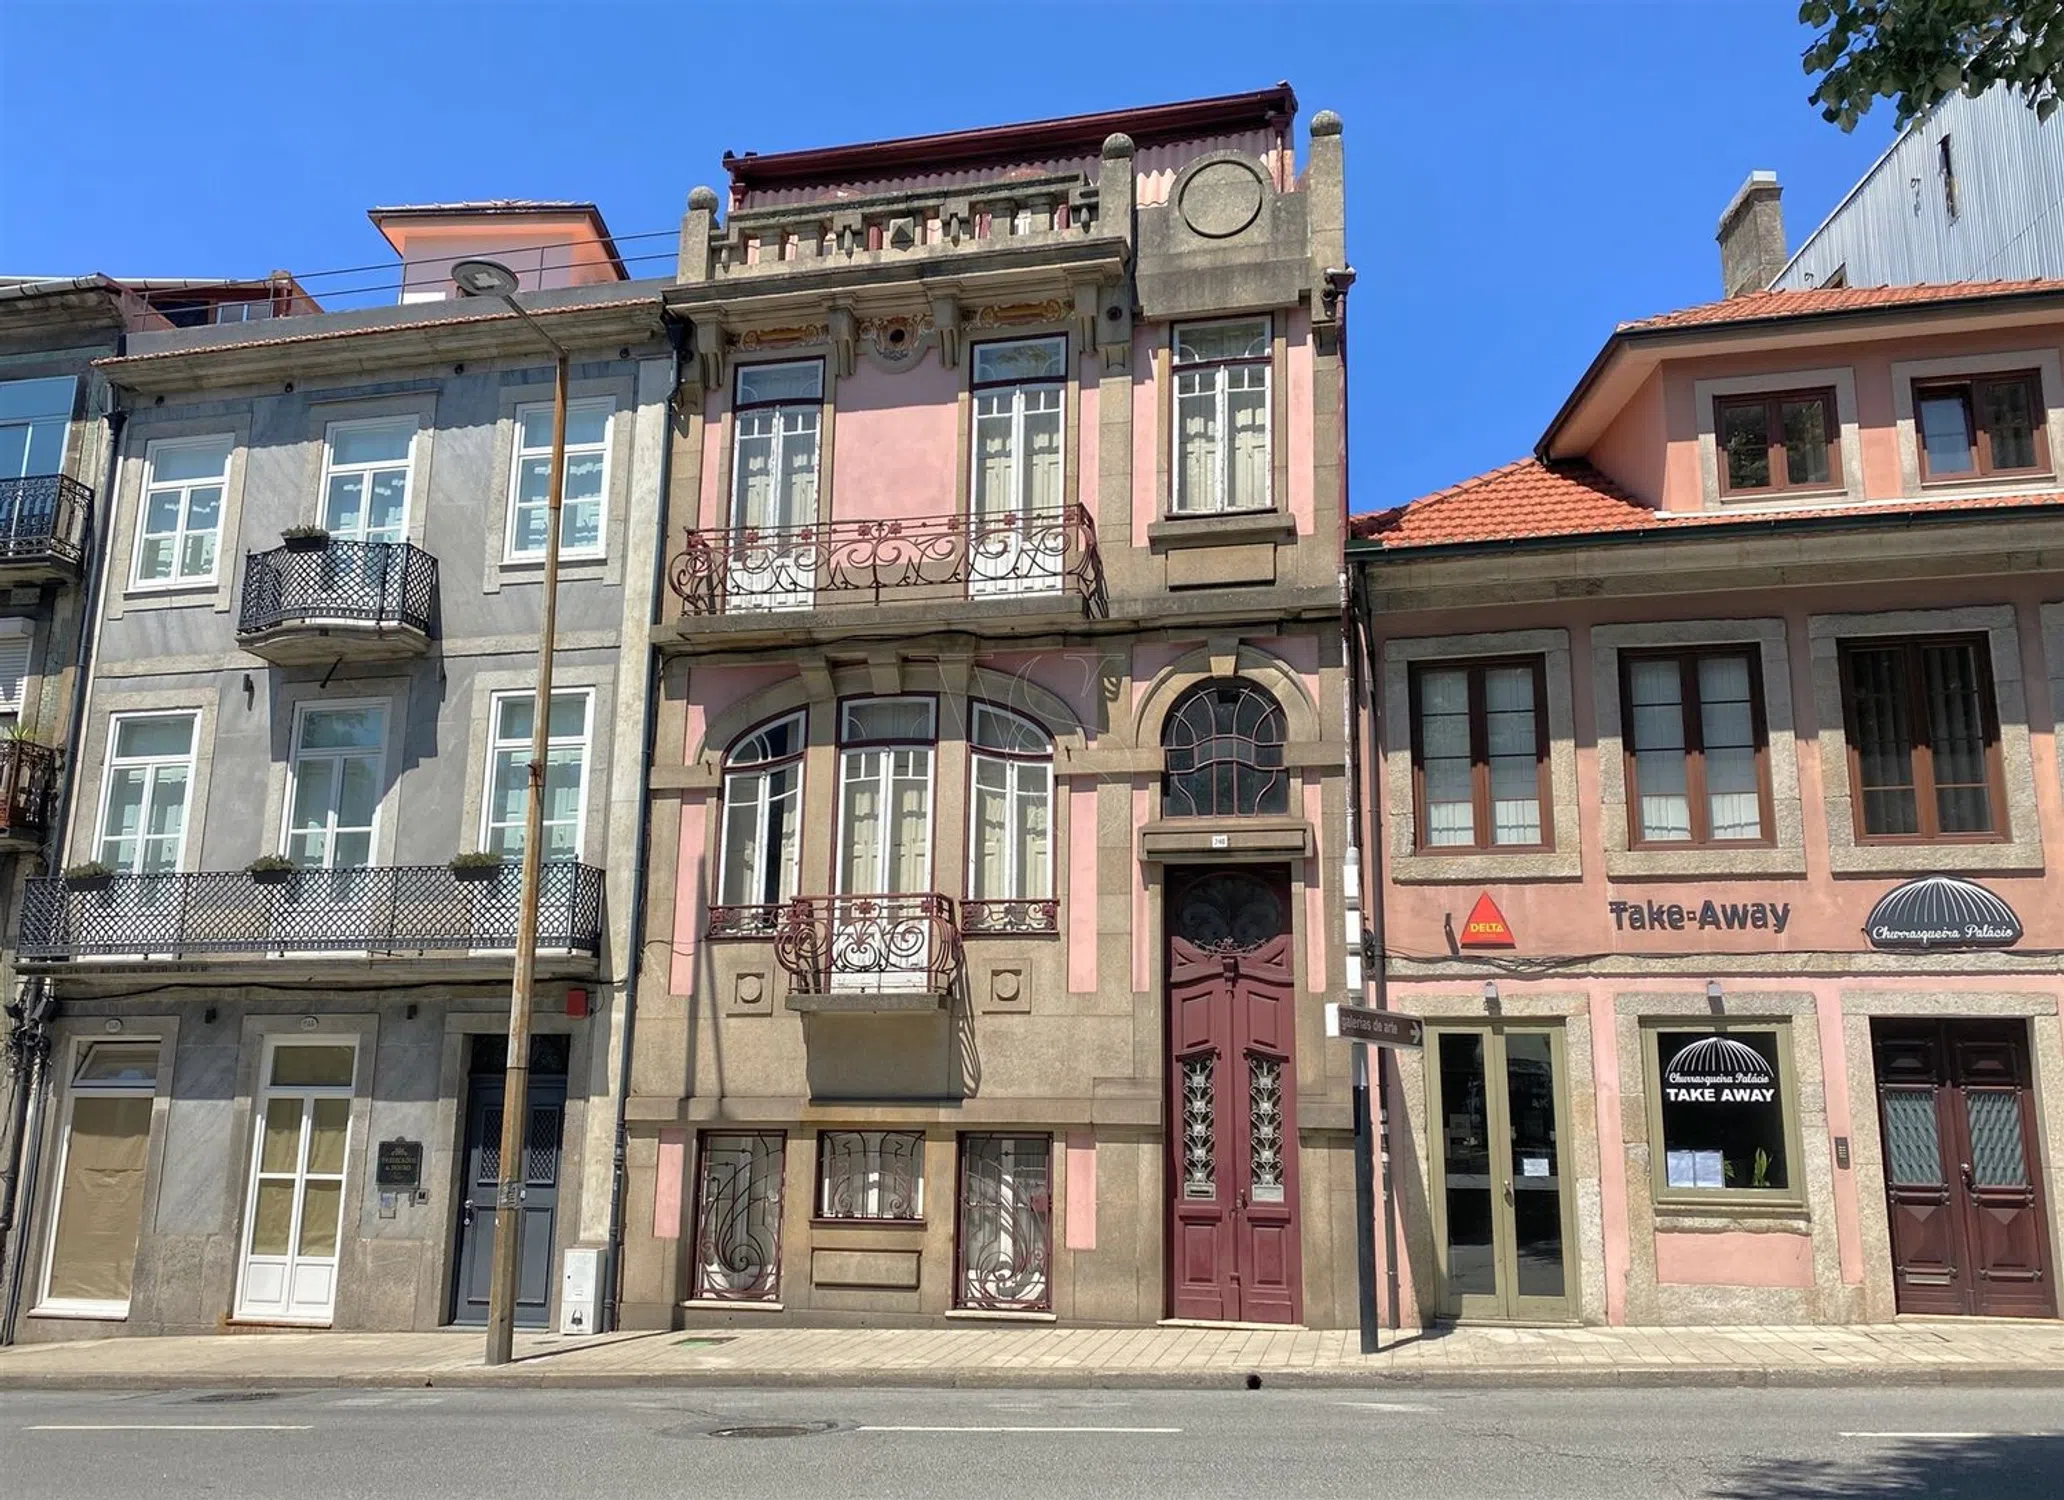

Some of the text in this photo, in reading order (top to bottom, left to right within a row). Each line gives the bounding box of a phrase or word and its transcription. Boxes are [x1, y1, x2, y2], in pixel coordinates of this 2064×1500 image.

[1609, 899, 1791, 934] Take-Away
[1470, 923, 1505, 933] DELTA
[1872, 923, 2013, 944] Churrasqueira Palácio
[1372, 1018, 1383, 1032] de
[1668, 1072, 1769, 1086] Churrasqueira Palácio
[1666, 1088, 1775, 1102] TAKE AWAY
